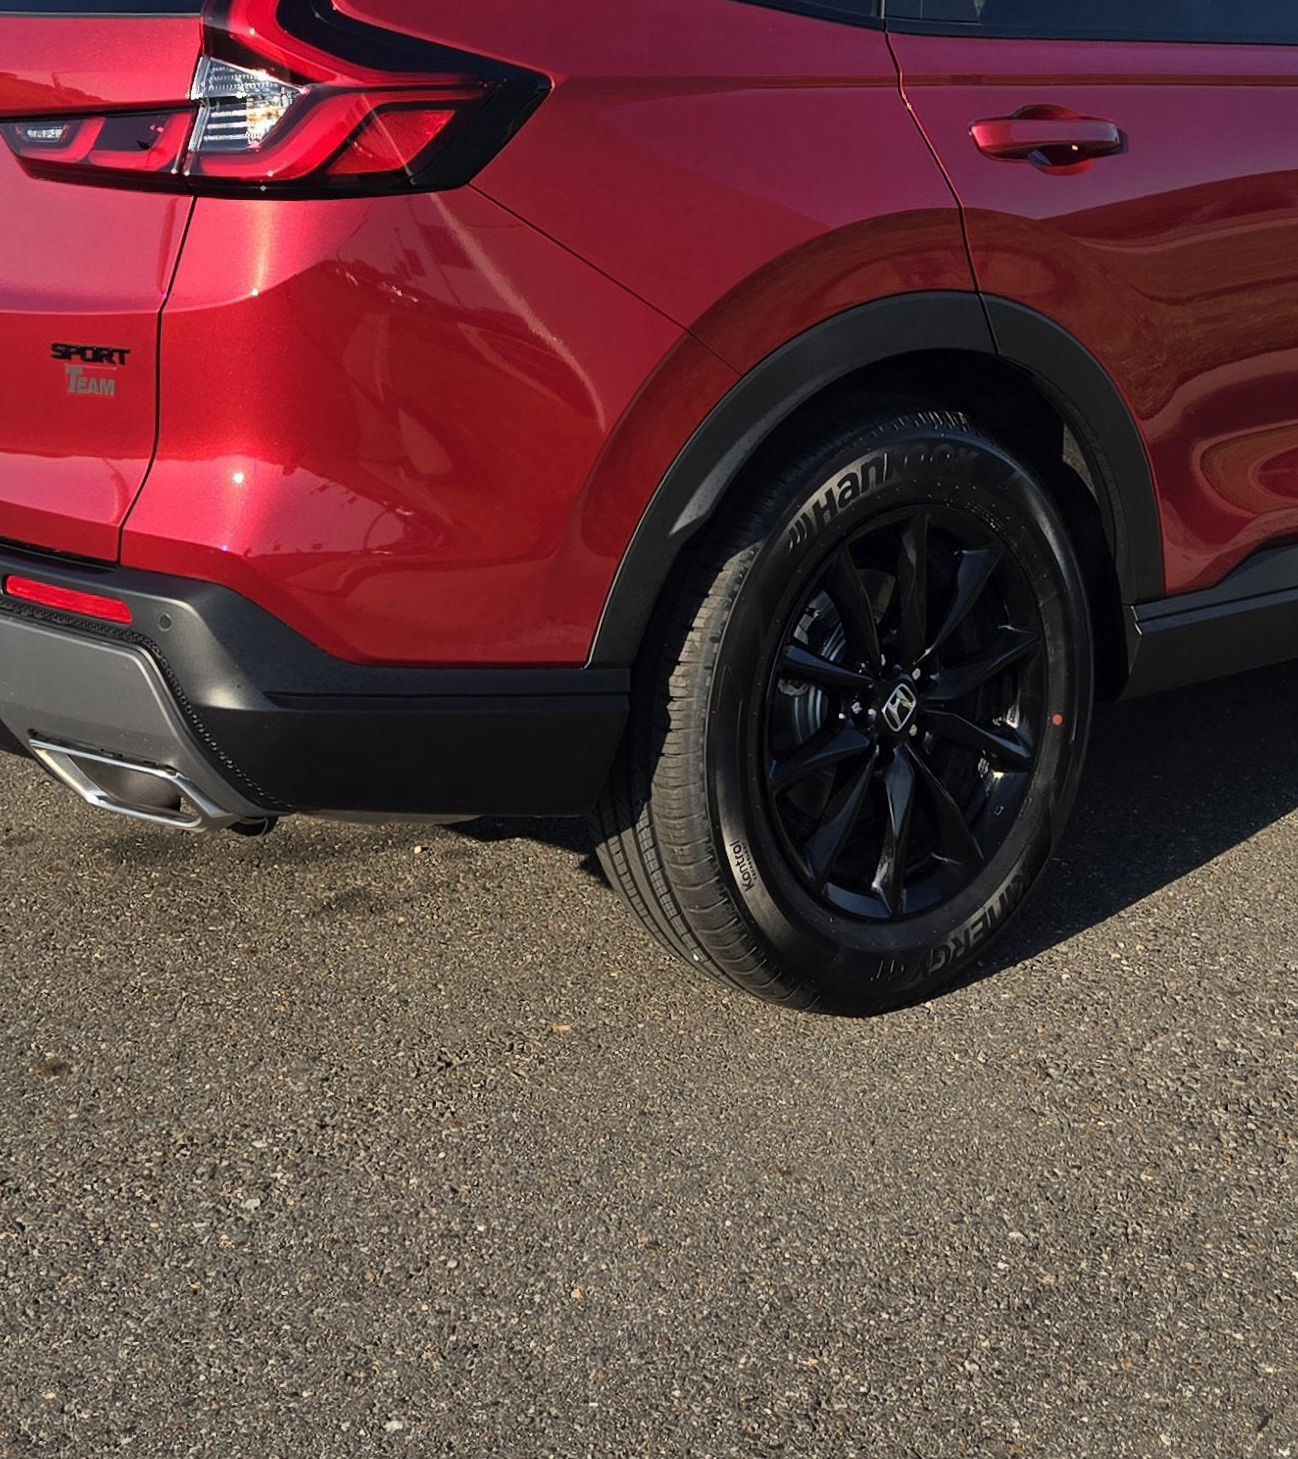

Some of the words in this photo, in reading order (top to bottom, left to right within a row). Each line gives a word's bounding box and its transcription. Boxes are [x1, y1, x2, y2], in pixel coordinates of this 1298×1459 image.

[50, 342, 131, 366] SPORT
[64, 365, 117, 396] TEAM
[729, 840, 755, 891] Kontrol
